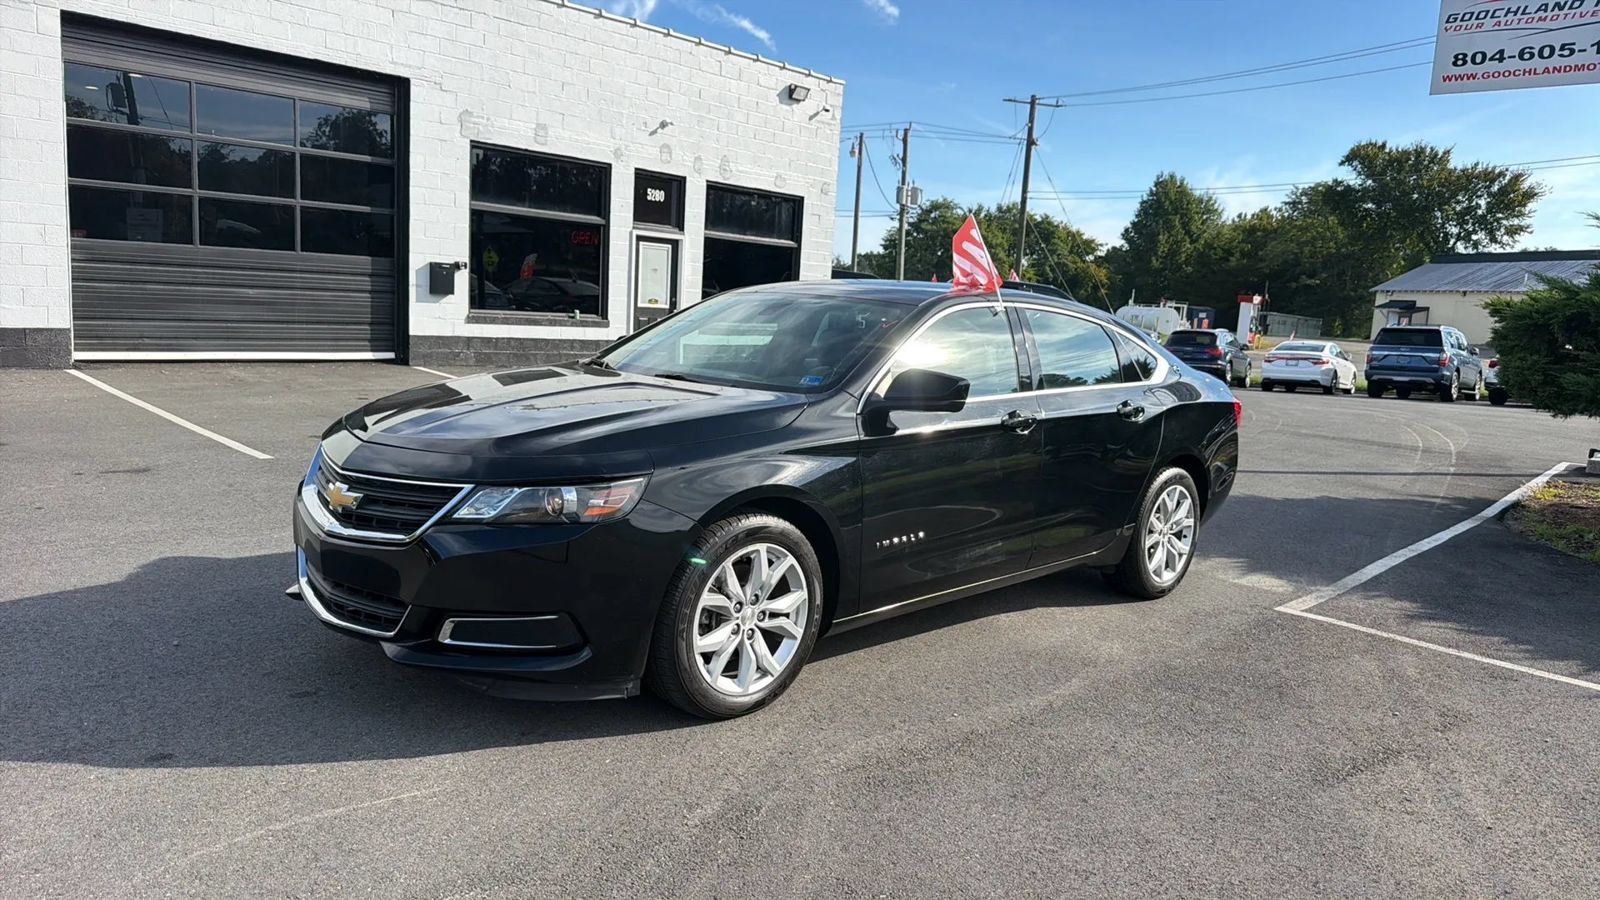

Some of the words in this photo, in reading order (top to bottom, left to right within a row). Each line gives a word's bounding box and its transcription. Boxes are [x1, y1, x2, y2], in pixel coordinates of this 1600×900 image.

[1444, 22, 1485, 33] YOUR
[1492, 10, 1600, 28] AUTOMOTIVE
[1445, 0, 1585, 24] GOOCHLAND
[647, 187, 665, 202] 5280
[571, 230, 599, 245] OPEN
